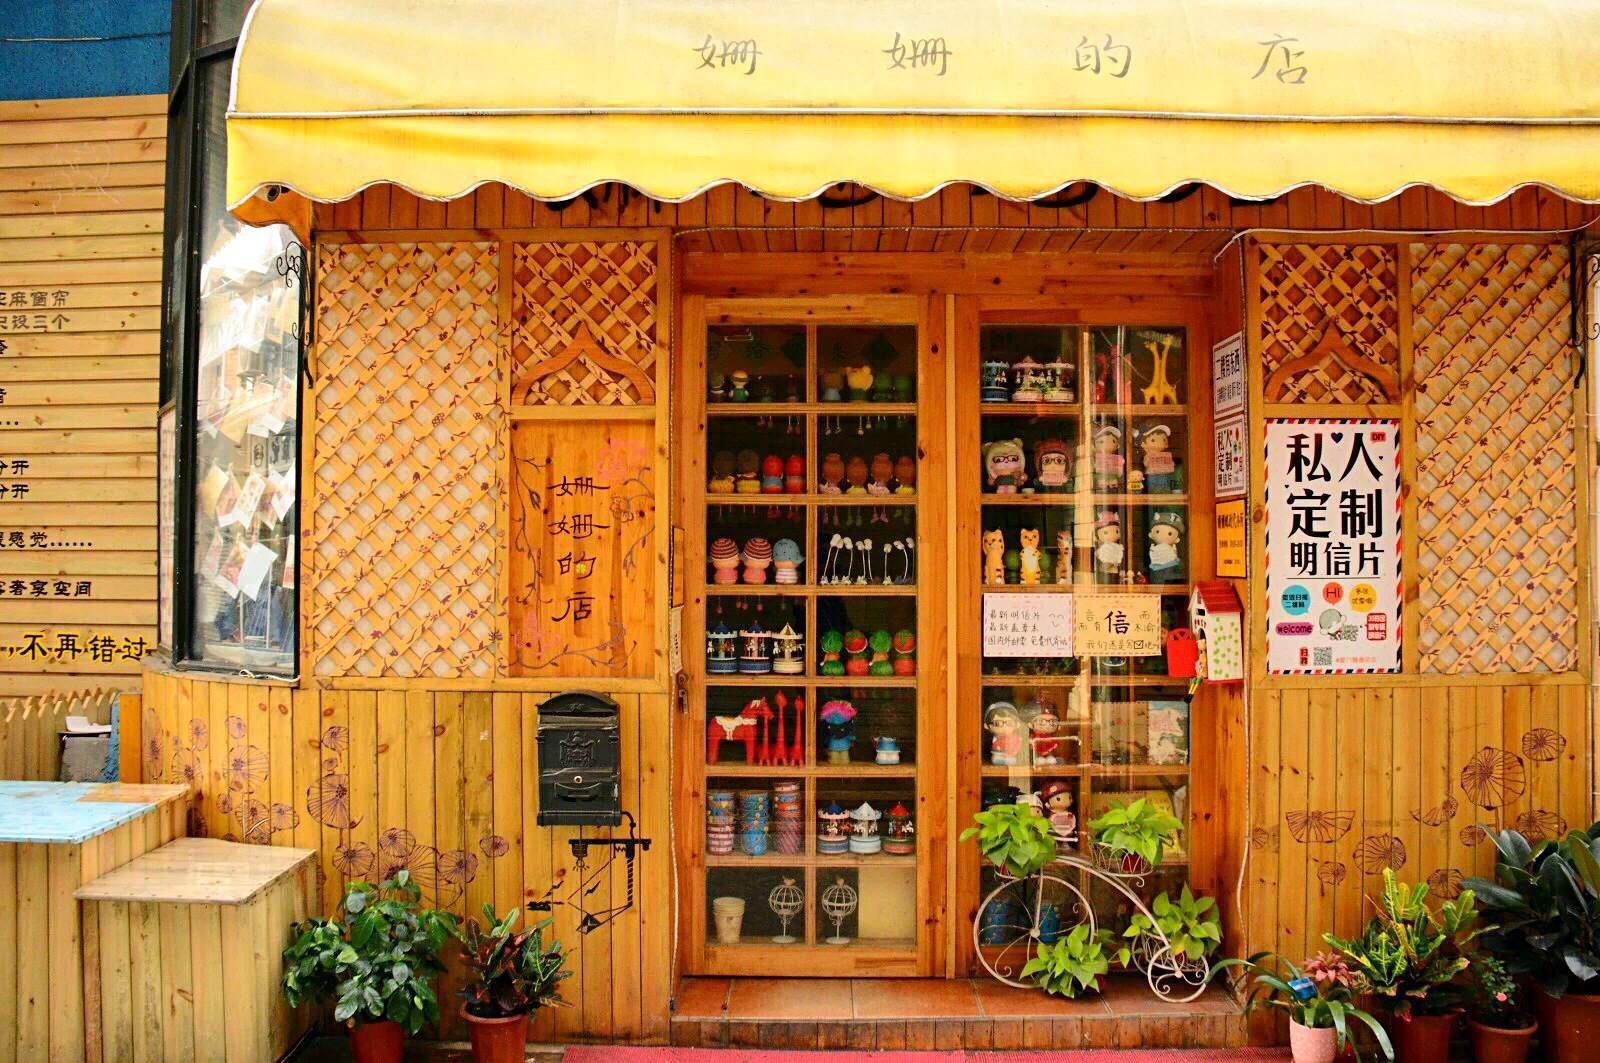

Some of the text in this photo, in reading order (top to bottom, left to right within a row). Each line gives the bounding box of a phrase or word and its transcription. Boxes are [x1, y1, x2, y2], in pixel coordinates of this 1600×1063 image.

[1286, 432, 1383, 482] 私人
[1286, 488, 1383, 539] 定制
[1289, 542, 1385, 576] 明信片
[1326, 587, 1340, 598] Hi
[1104, 610, 1131, 634] 信
[1277, 624, 1313, 634] welcome
